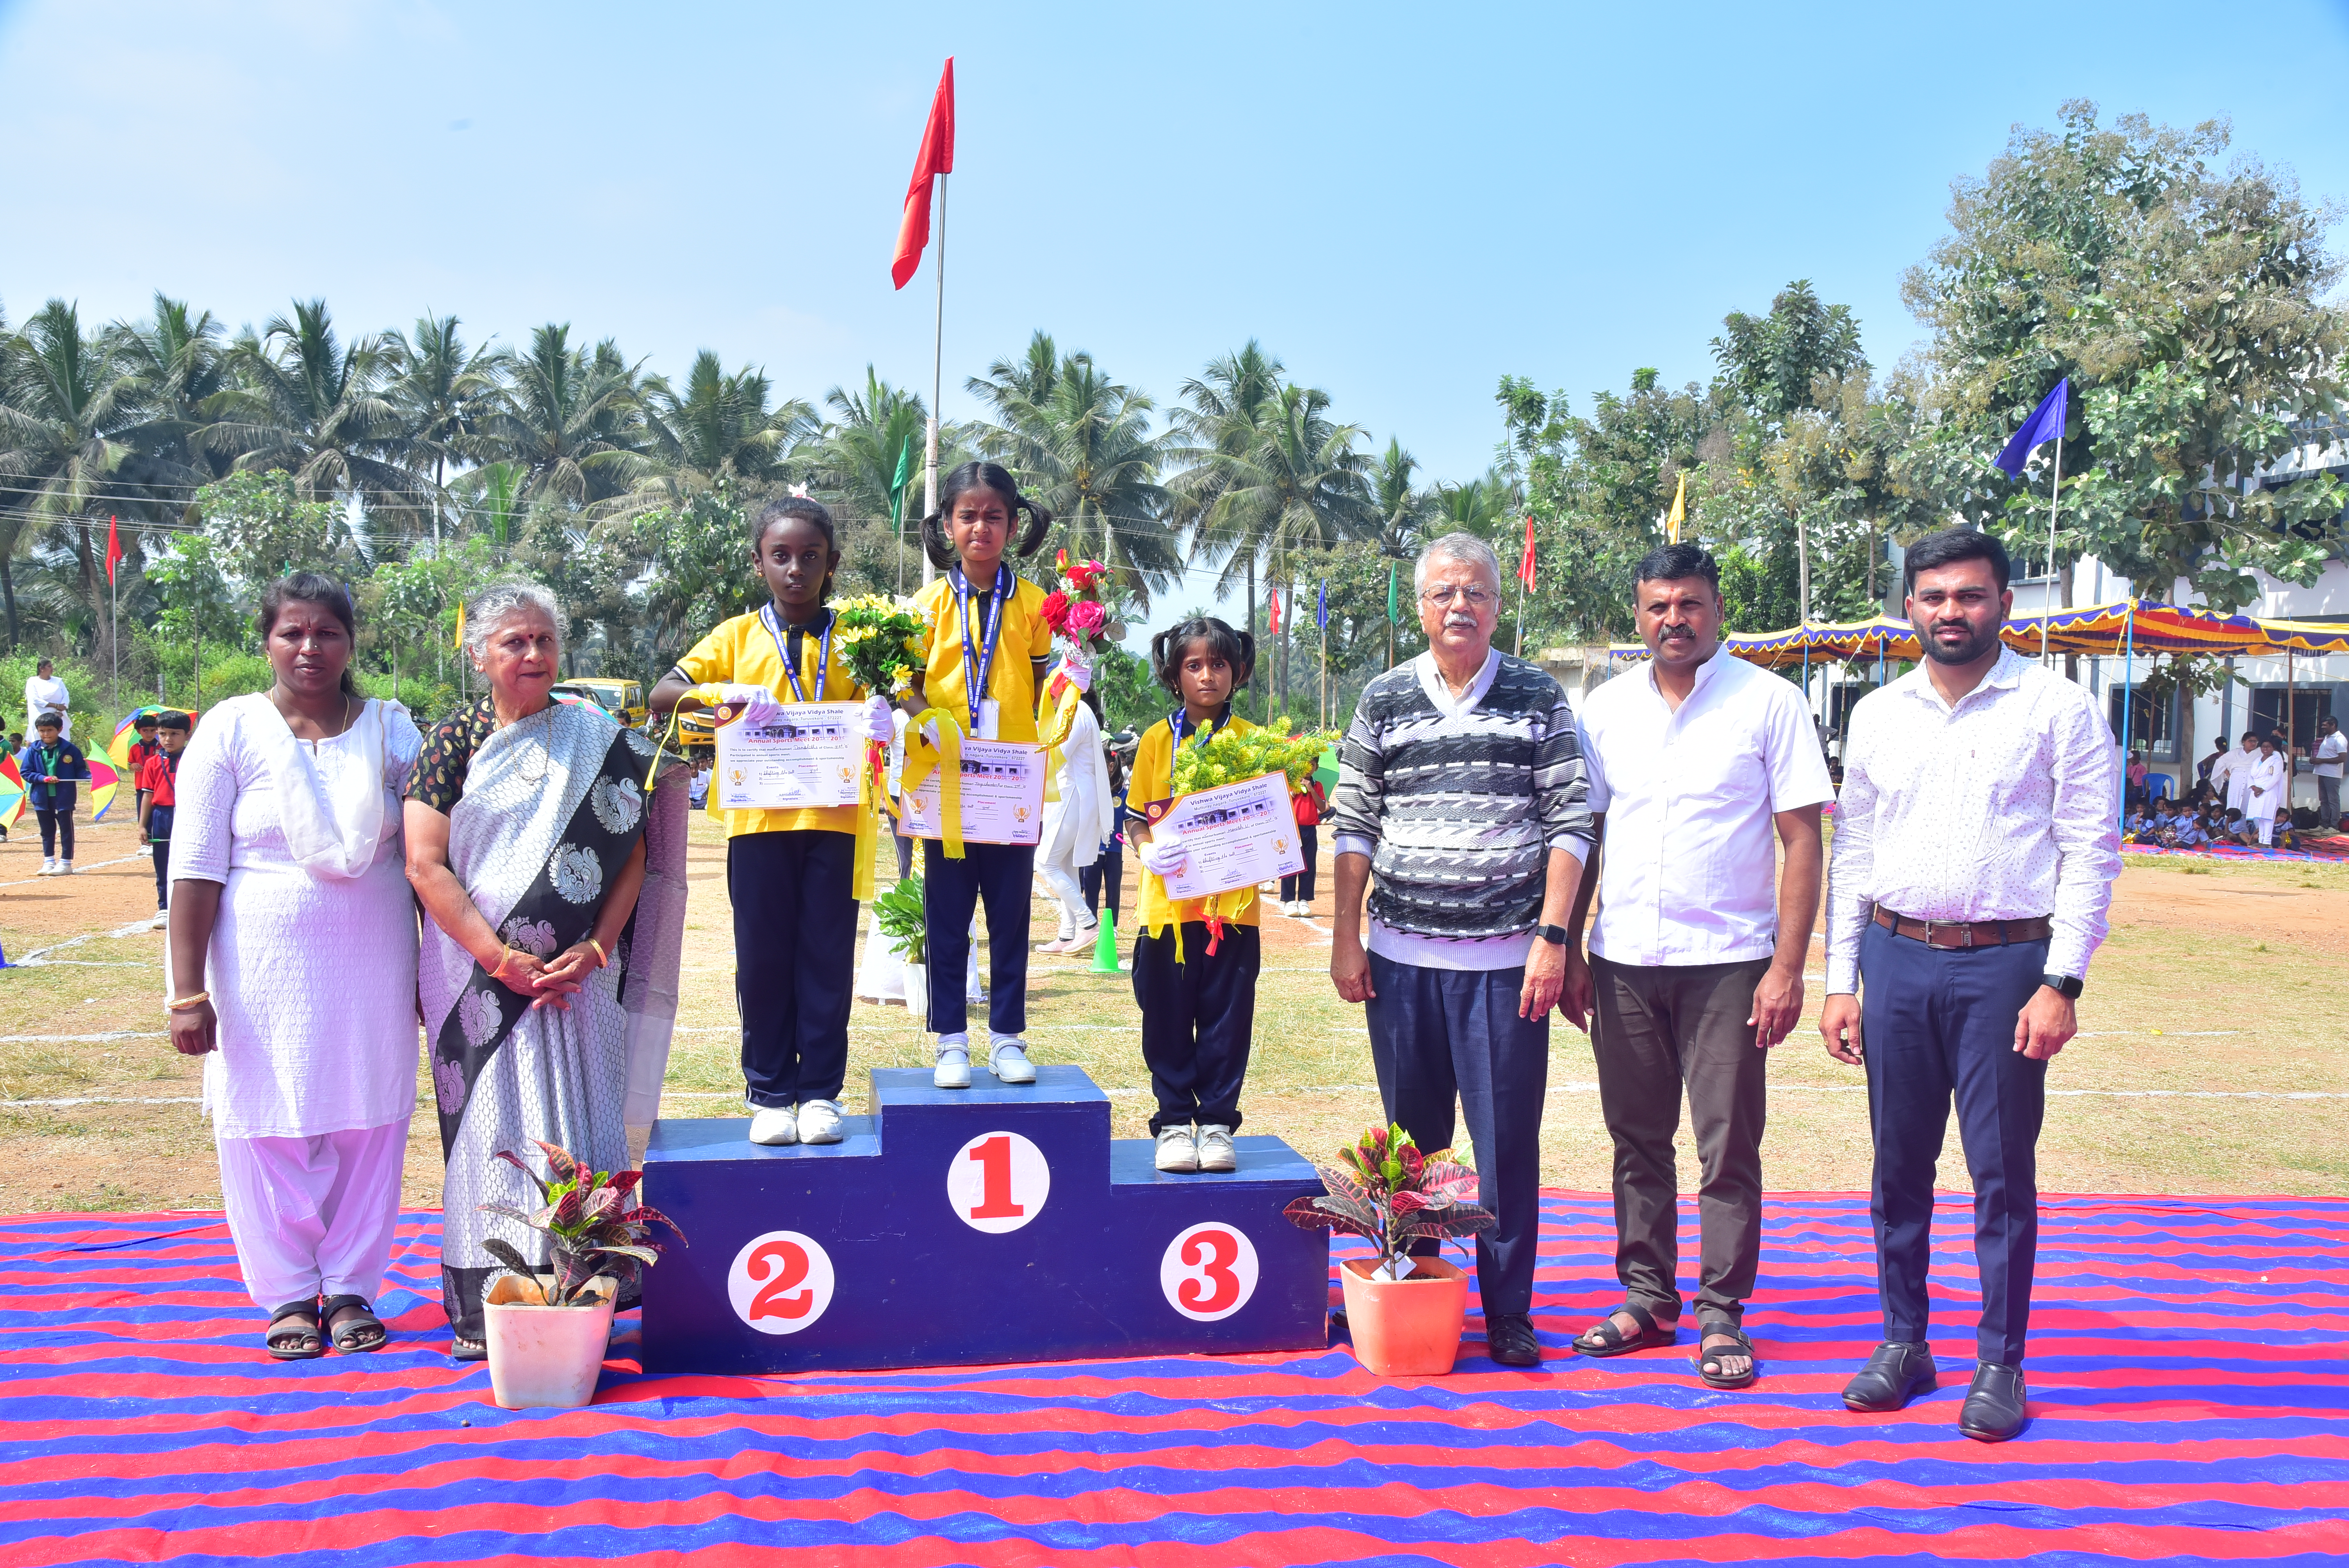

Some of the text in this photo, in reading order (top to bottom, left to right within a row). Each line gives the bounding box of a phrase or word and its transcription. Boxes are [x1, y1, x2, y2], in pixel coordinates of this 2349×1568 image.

[1190, 797, 1213, 805] Vishwa
[1214, 792, 1233, 800] Vijaya
[1182, 826, 1205, 835] Annual
[1206, 821, 1225, 830] Sports
[1222, 837, 1249, 845] accomplishment
[970, 1137, 1023, 1219] 1
[747, 1241, 813, 1320] 2
[1178, 1230, 1239, 1313] 3
